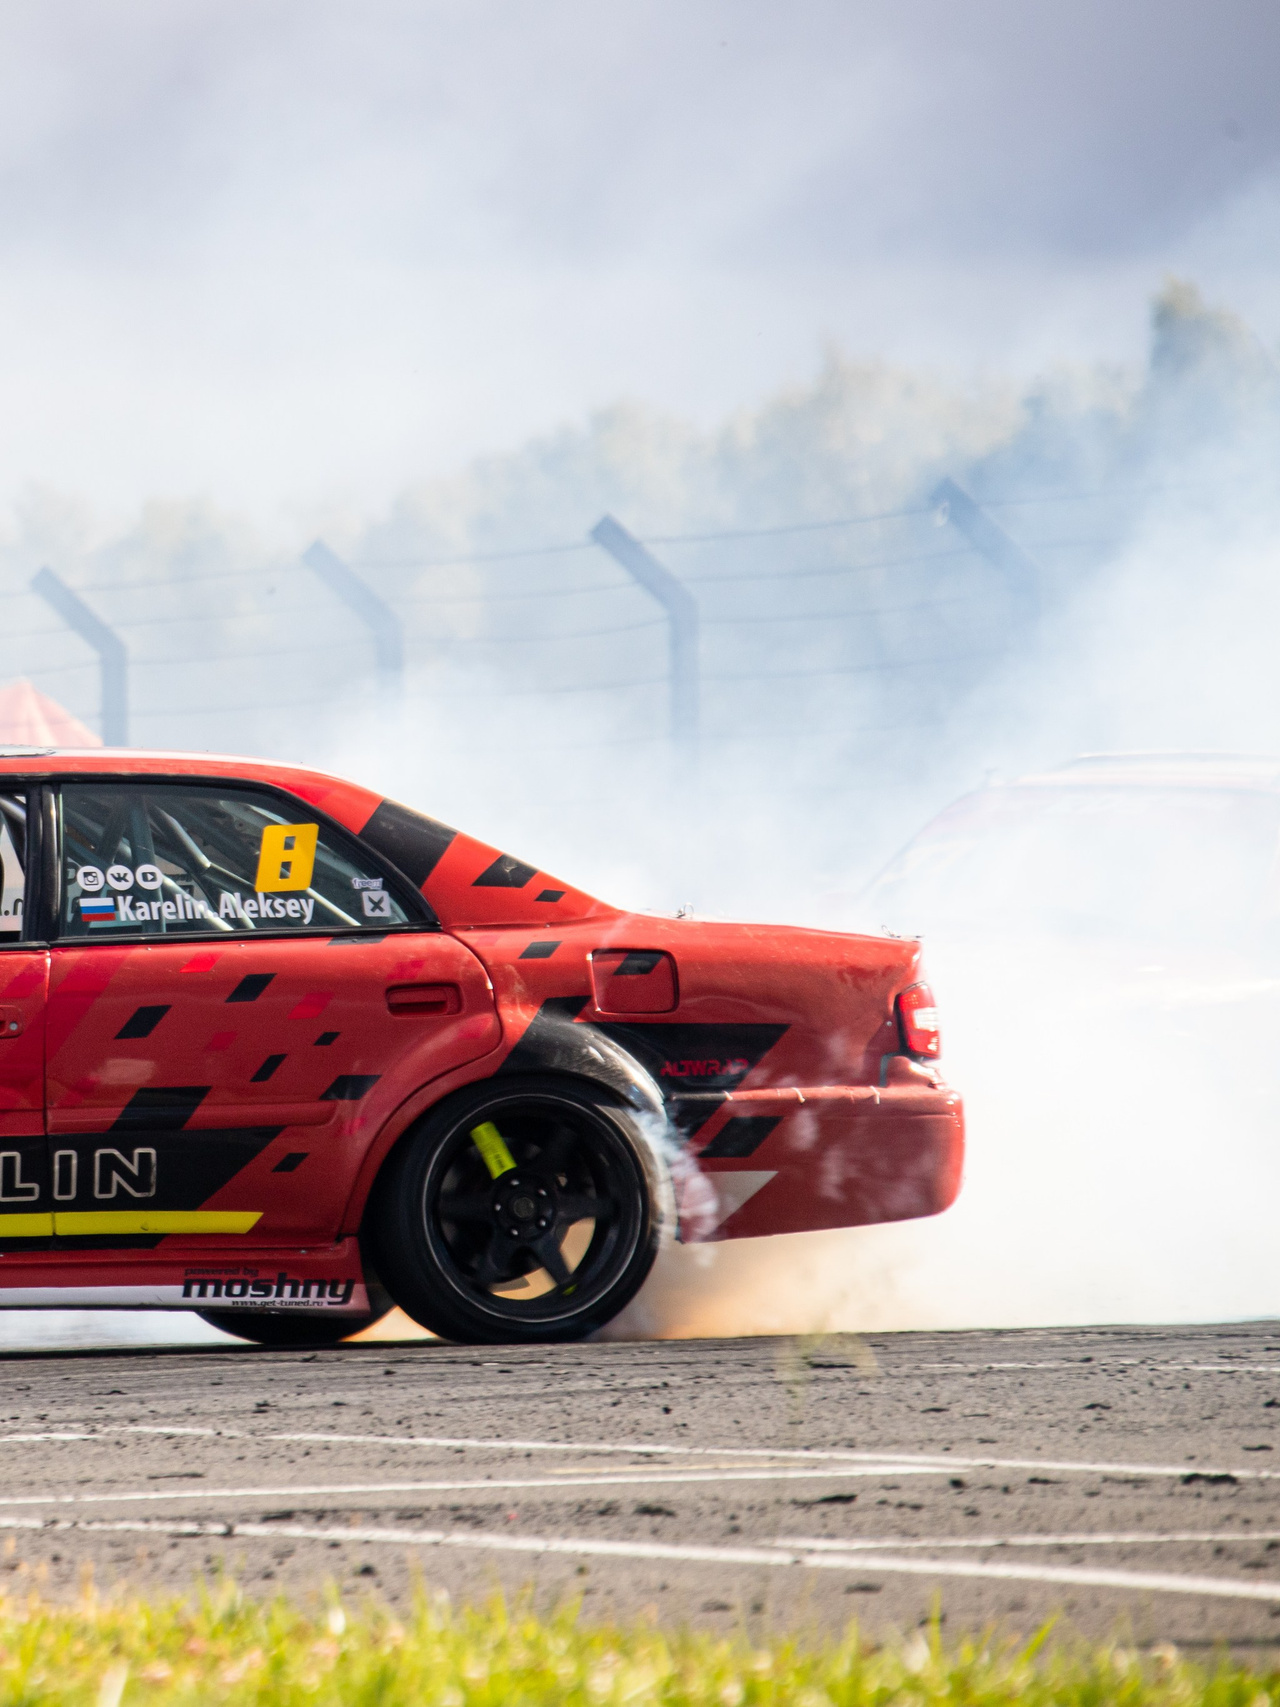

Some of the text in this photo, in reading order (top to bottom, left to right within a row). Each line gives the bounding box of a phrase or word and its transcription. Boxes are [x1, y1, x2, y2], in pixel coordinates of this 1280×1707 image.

[255, 823, 319, 893] 8
[182, 1272, 355, 1305] moshny
[184, 1266, 260, 1278] powered by
